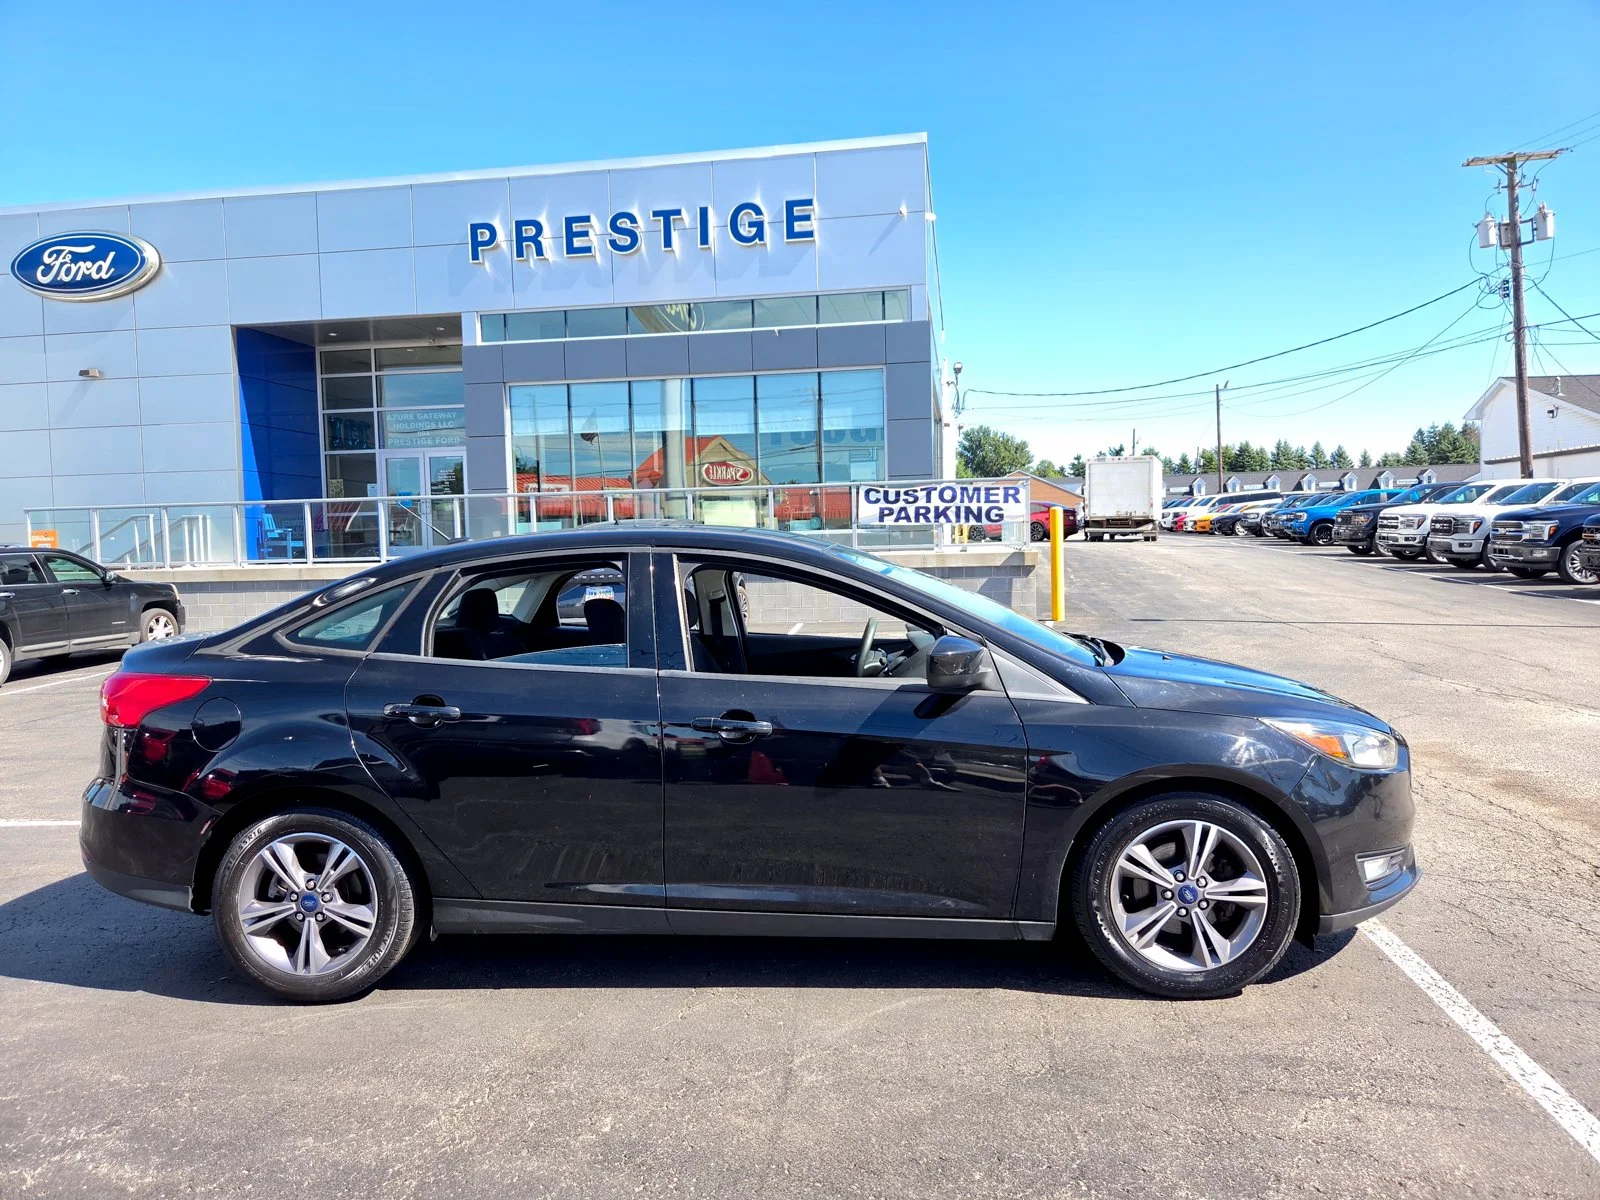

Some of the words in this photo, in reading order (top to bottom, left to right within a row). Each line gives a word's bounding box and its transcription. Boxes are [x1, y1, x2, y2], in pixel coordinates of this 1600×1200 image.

[469, 198, 815, 263] PRESTIGE
[36, 245, 116, 284] Ford
[387, 413, 415, 421] AZURE
[388, 438, 433, 446] PRESTIGE
[436, 436, 460, 444] FORD
[864, 486, 1021, 504] CUSTOMER
[878, 505, 1005, 523] PARKING
